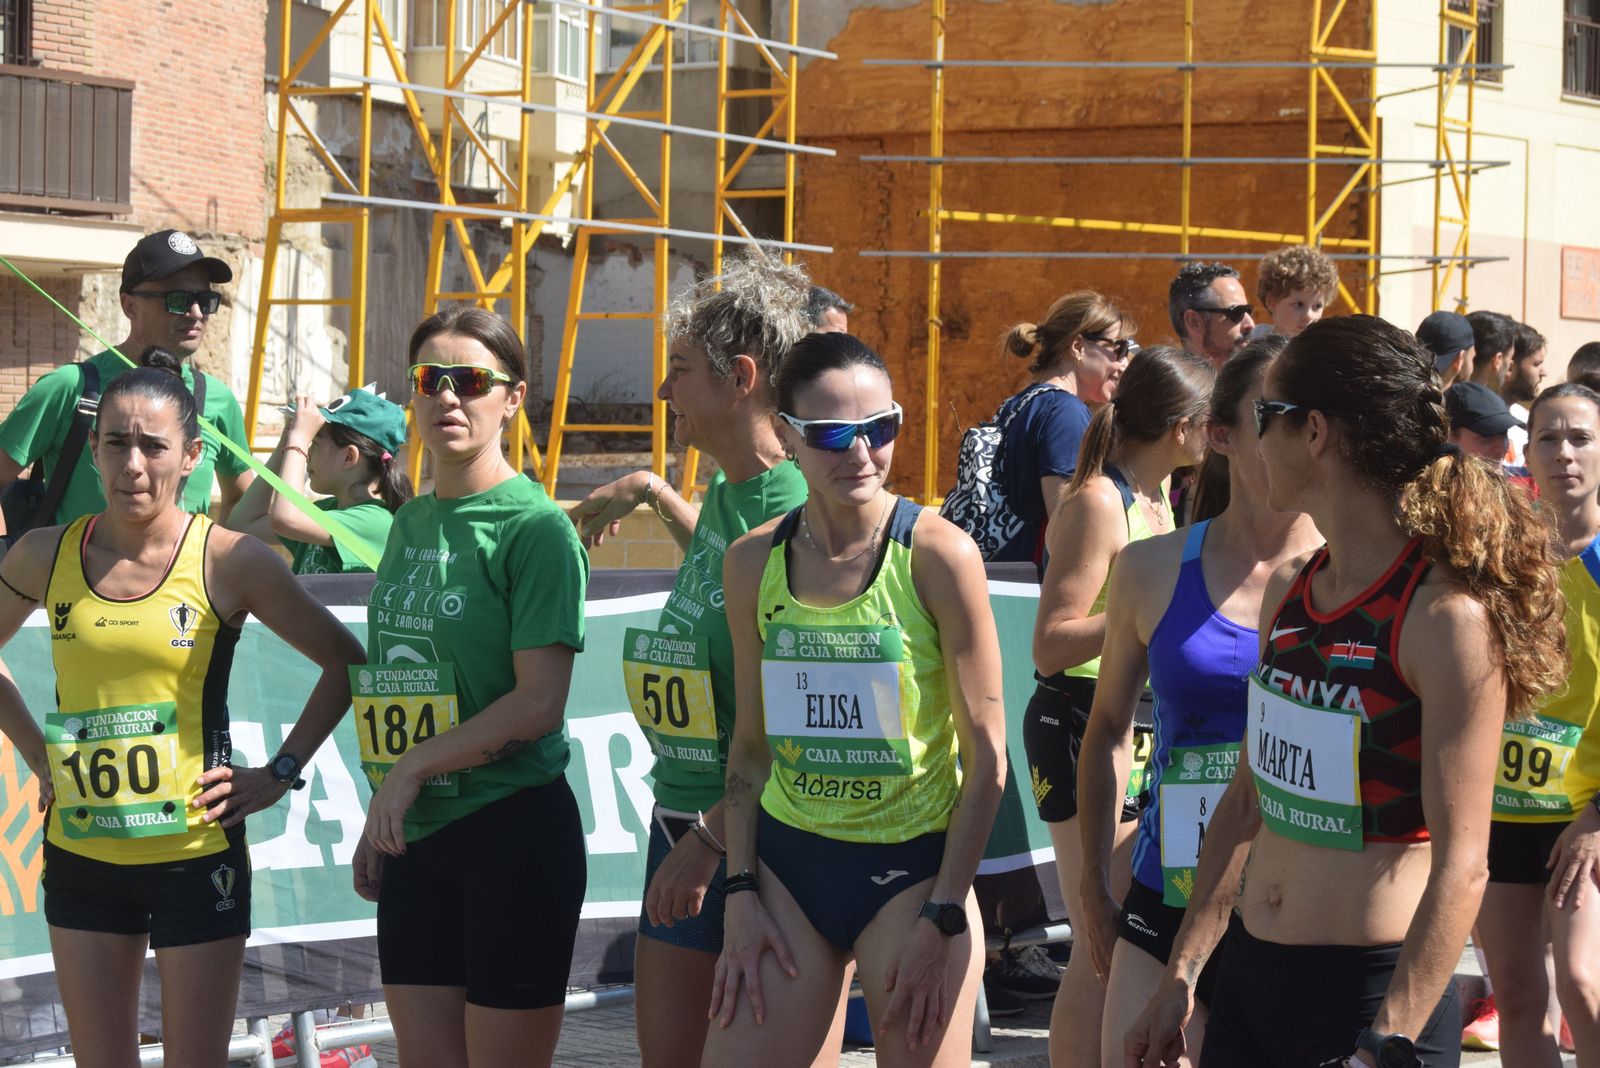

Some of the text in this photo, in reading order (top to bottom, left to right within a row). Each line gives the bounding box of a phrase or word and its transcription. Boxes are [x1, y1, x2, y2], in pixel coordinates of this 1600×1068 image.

[377, 611, 434, 631] DE ZAMORA
[171, 639, 194, 647] GCB
[798, 631, 881, 646] FUNDACION
[650, 650, 671, 663] CAJA
[799, 646, 881, 659] CAJA RURAL
[375, 669, 438, 681] FUNDACION
[796, 672, 808, 690] 13
[376, 682, 439, 693] CAJA RURAL
[643, 673, 690, 729] 50
[85, 709, 158, 727] FUNDACION
[805, 694, 864, 729] ELISA
[1260, 702, 1266, 722] 9
[86, 721, 156, 739] CAJA RURAL
[363, 703, 436, 756] 184
[1503, 722, 1525, 733] CAJA
[1528, 726, 1563, 742] RURAL
[658, 743, 676, 758] AJA
[676, 746, 716, 762] RURAL
[805, 748, 902, 765] CAJA RURAL
[1258, 728, 1316, 791] MARTA
[62, 744, 160, 799] 160
[1503, 741, 1552, 787] 99
[425, 773, 451, 786] RAL
[793, 771, 882, 801] Adarsa
[1200, 797, 1206, 816] 8
[1496, 794, 1565, 809] CAJA RURAL
[95, 810, 178, 828] CAJA RURAL
[1261, 794, 1352, 835] CAJA RURAL
